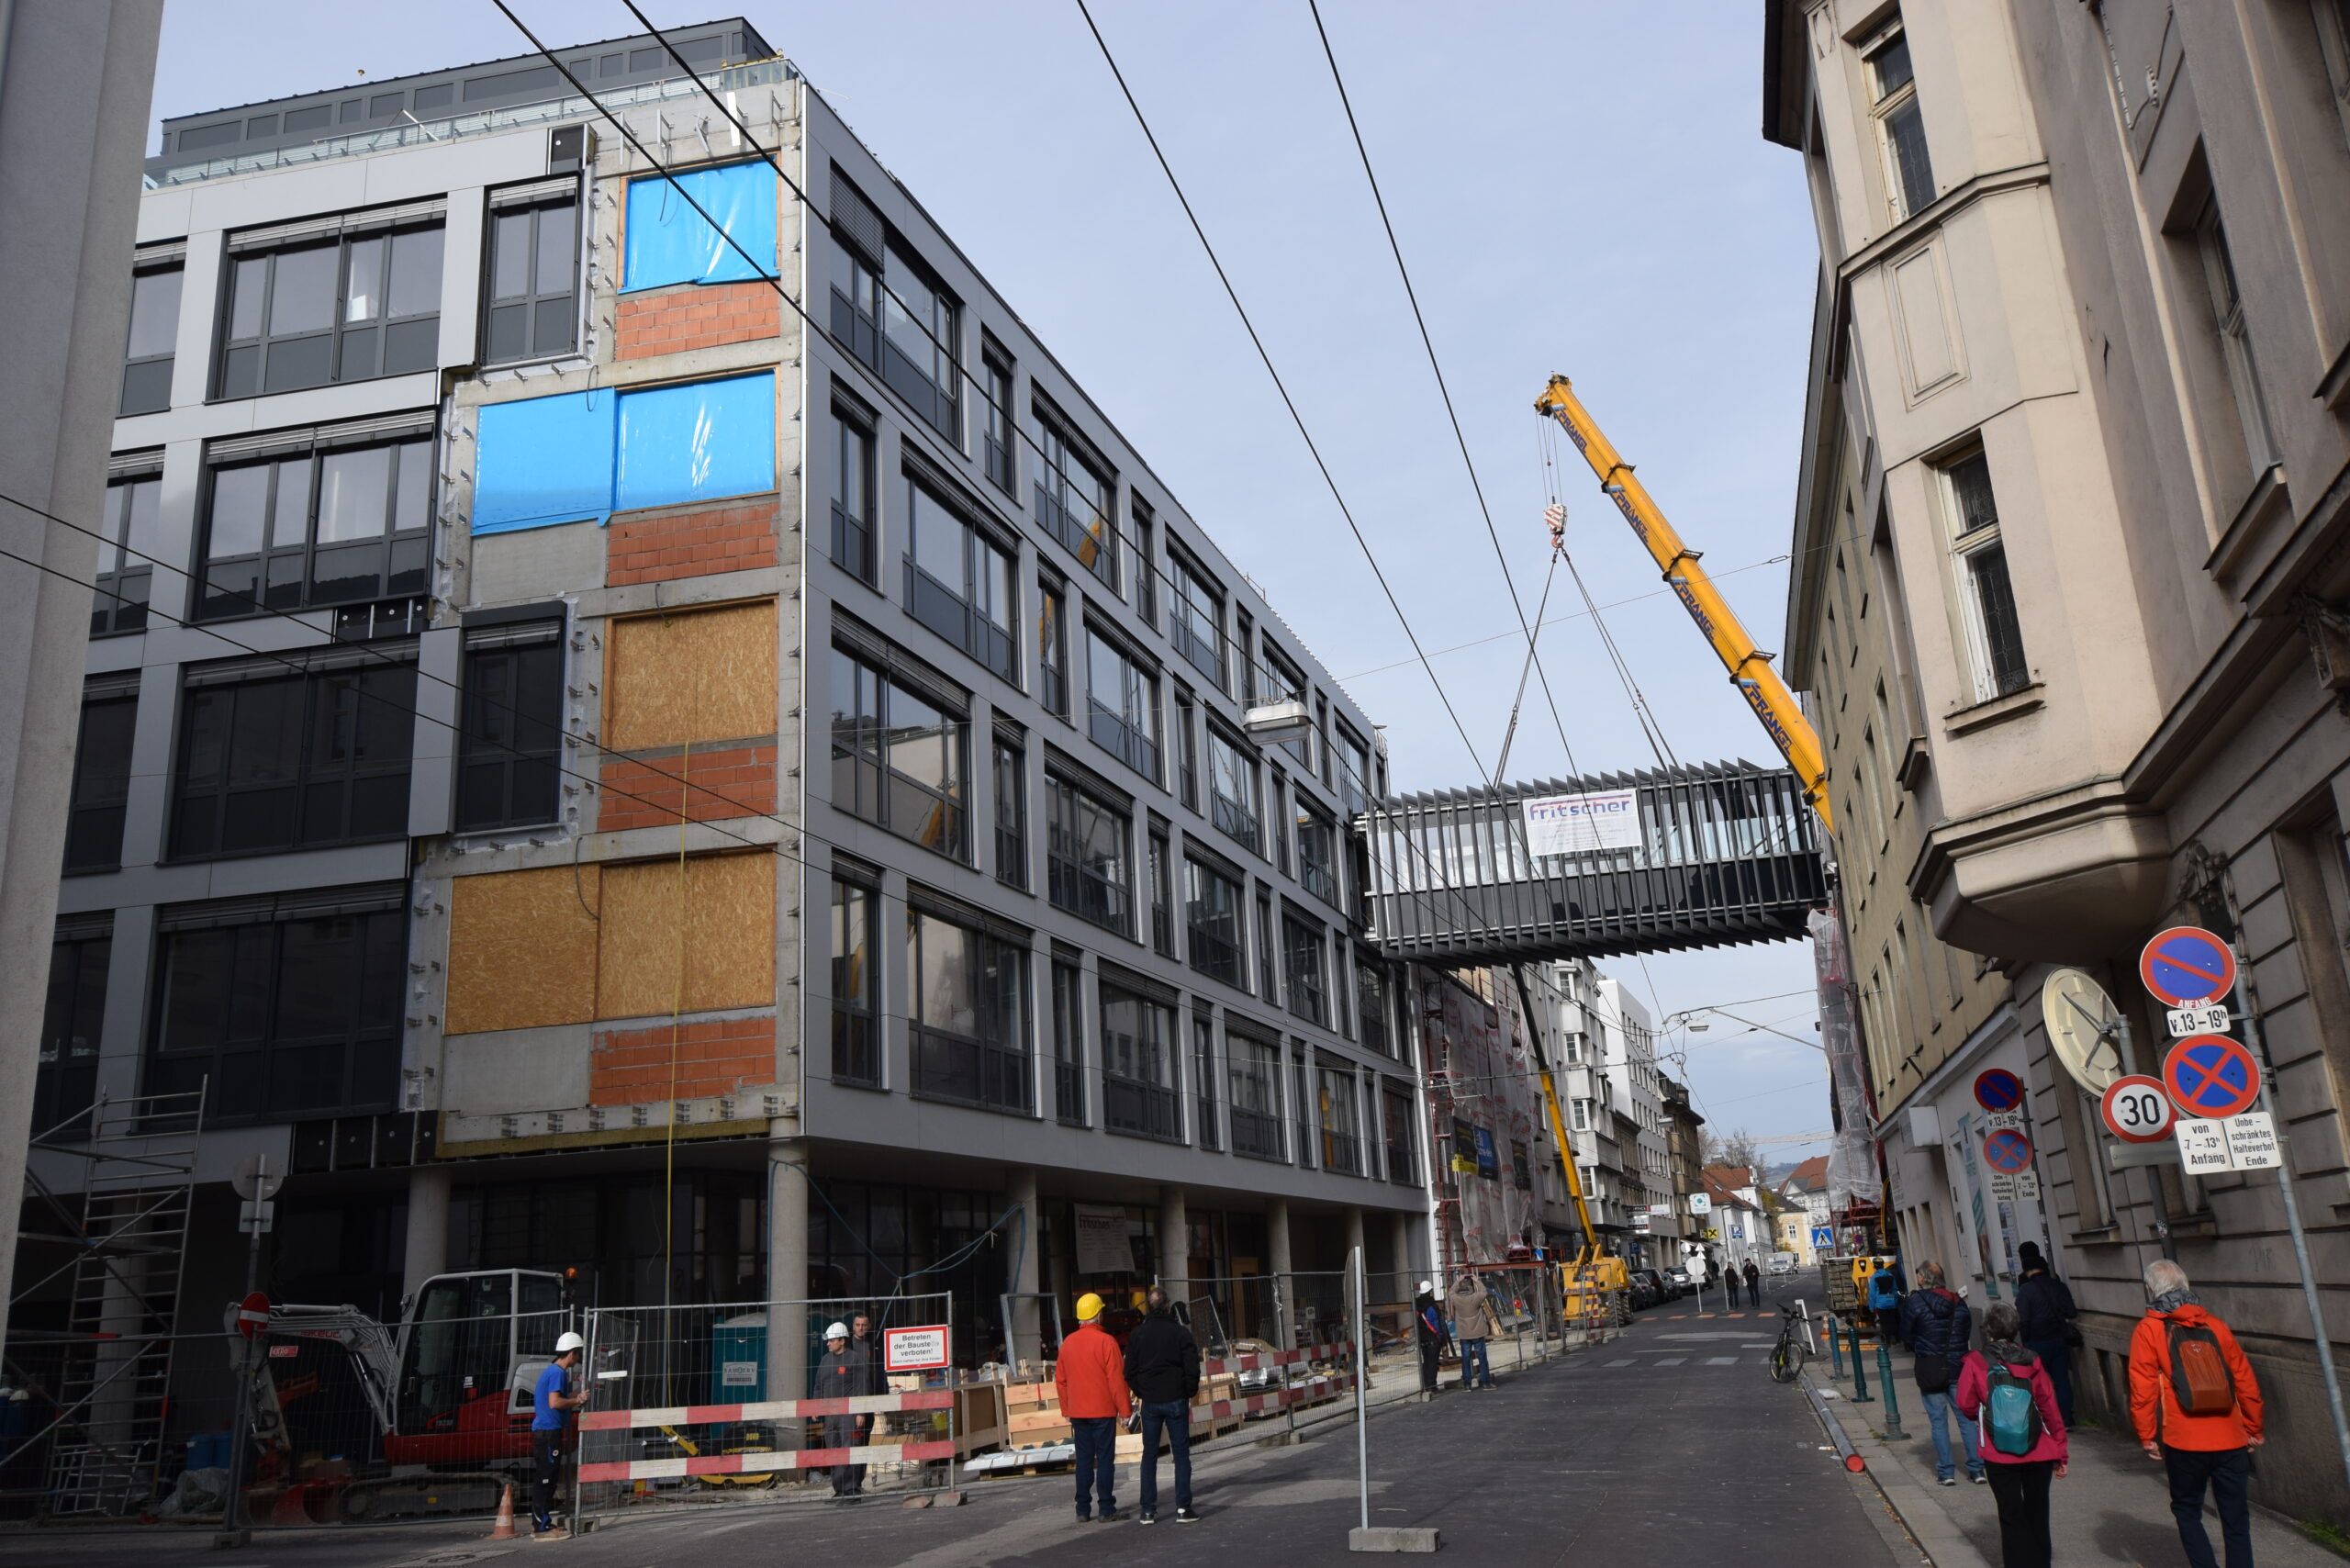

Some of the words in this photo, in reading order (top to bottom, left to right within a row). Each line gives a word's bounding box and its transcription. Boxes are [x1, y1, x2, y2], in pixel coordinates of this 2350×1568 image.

[1679, 581, 1715, 641] PRANGL
[1749, 684, 1793, 756] PRANGL
[1529, 795, 1631, 820] fritscher
[2177, 997, 2211, 1009] ANFANG
[2207, 1010, 2227, 1028] 19h
[2121, 1094, 2161, 1126] 30
[2192, 1125, 2210, 1134] von
[2231, 1130, 2271, 1141] schränktes
[2232, 1142, 2276, 1154] Halteverbot
[2191, 1154, 2225, 1165] Anfang
[2245, 1157, 2267, 1166] Ende
[901, 1348, 933, 1357] verboten!
